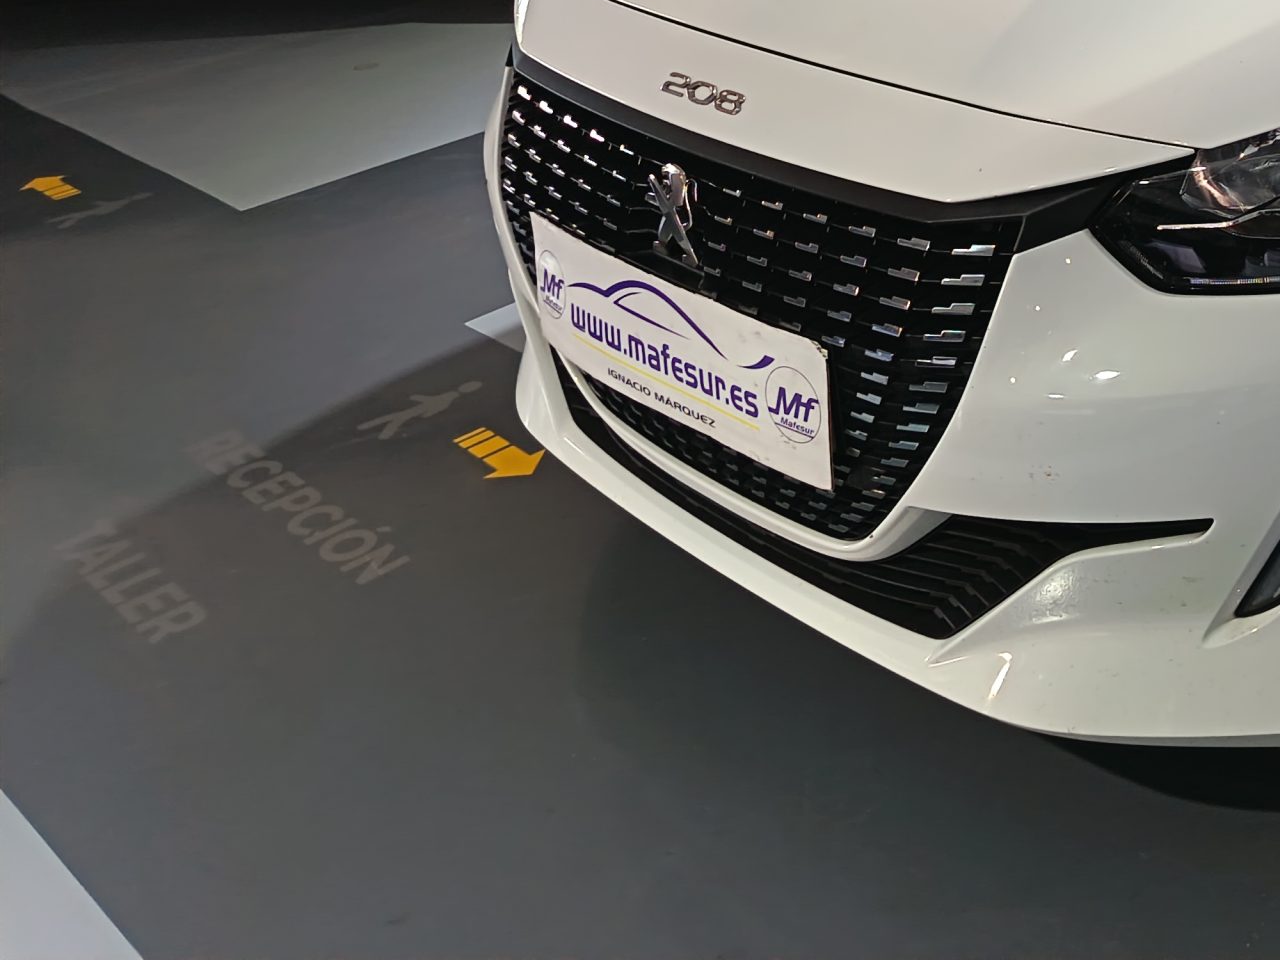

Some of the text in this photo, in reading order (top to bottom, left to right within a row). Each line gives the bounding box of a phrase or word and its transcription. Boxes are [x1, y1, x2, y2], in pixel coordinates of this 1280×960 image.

[660, 71, 747, 116] 208
[570, 301, 760, 418] www.mafesur.es
[607, 368, 651, 397] IGNACIO
[767, 386, 820, 423] Mf
[780, 416, 815, 435] Mafesur
[186, 429, 411, 585] RECEPCIÓN
[55, 517, 207, 644] TALLER
